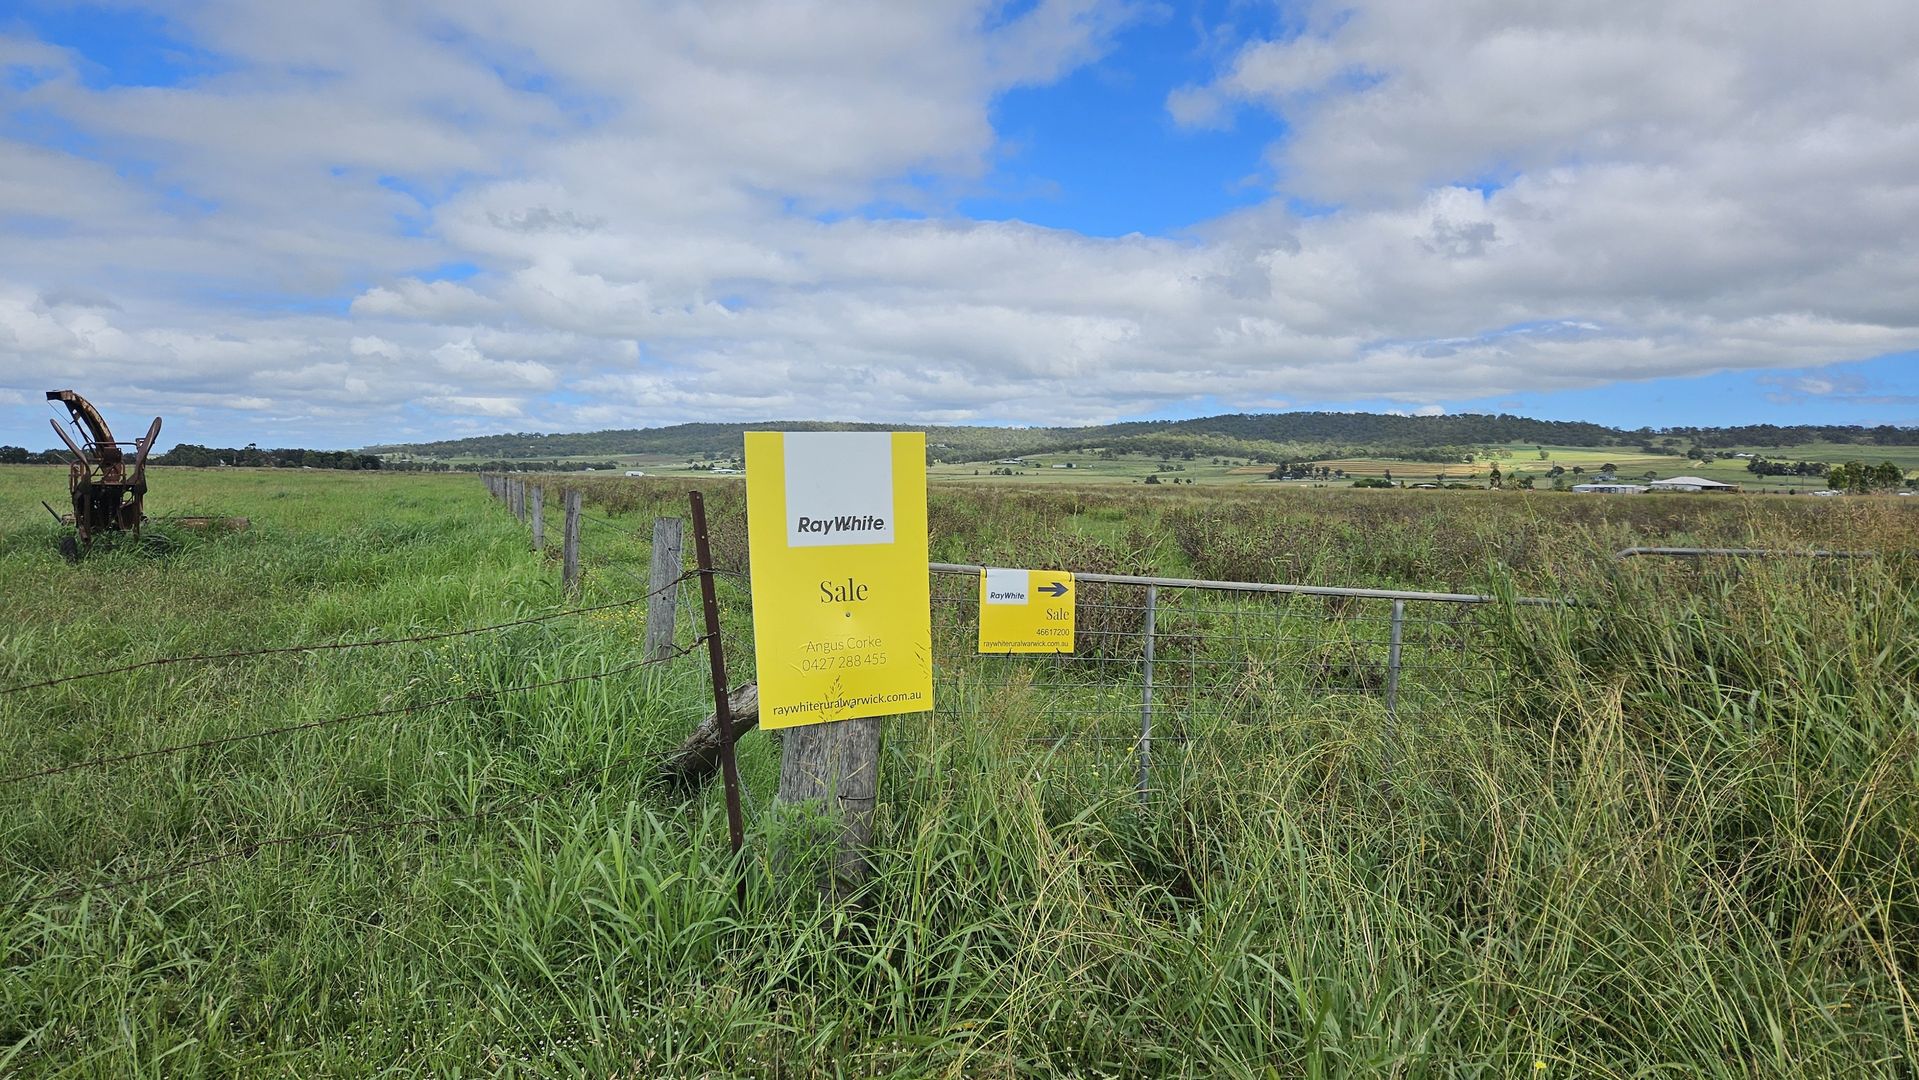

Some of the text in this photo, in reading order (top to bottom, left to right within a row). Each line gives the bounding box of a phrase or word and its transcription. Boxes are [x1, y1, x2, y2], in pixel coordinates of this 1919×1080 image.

[820, 577, 868, 603] Sale
[1046, 607, 1070, 621] Sale
[1036, 628, 1070, 636] 46617200
[806, 635, 882, 654] Angus Corke
[983, 640, 1069, 648] raywhiteruralwarwick.com.au
[802, 652, 887, 672] 0427 288 455
[773, 691, 922, 716] raywhiteruralwarwick.com.au
